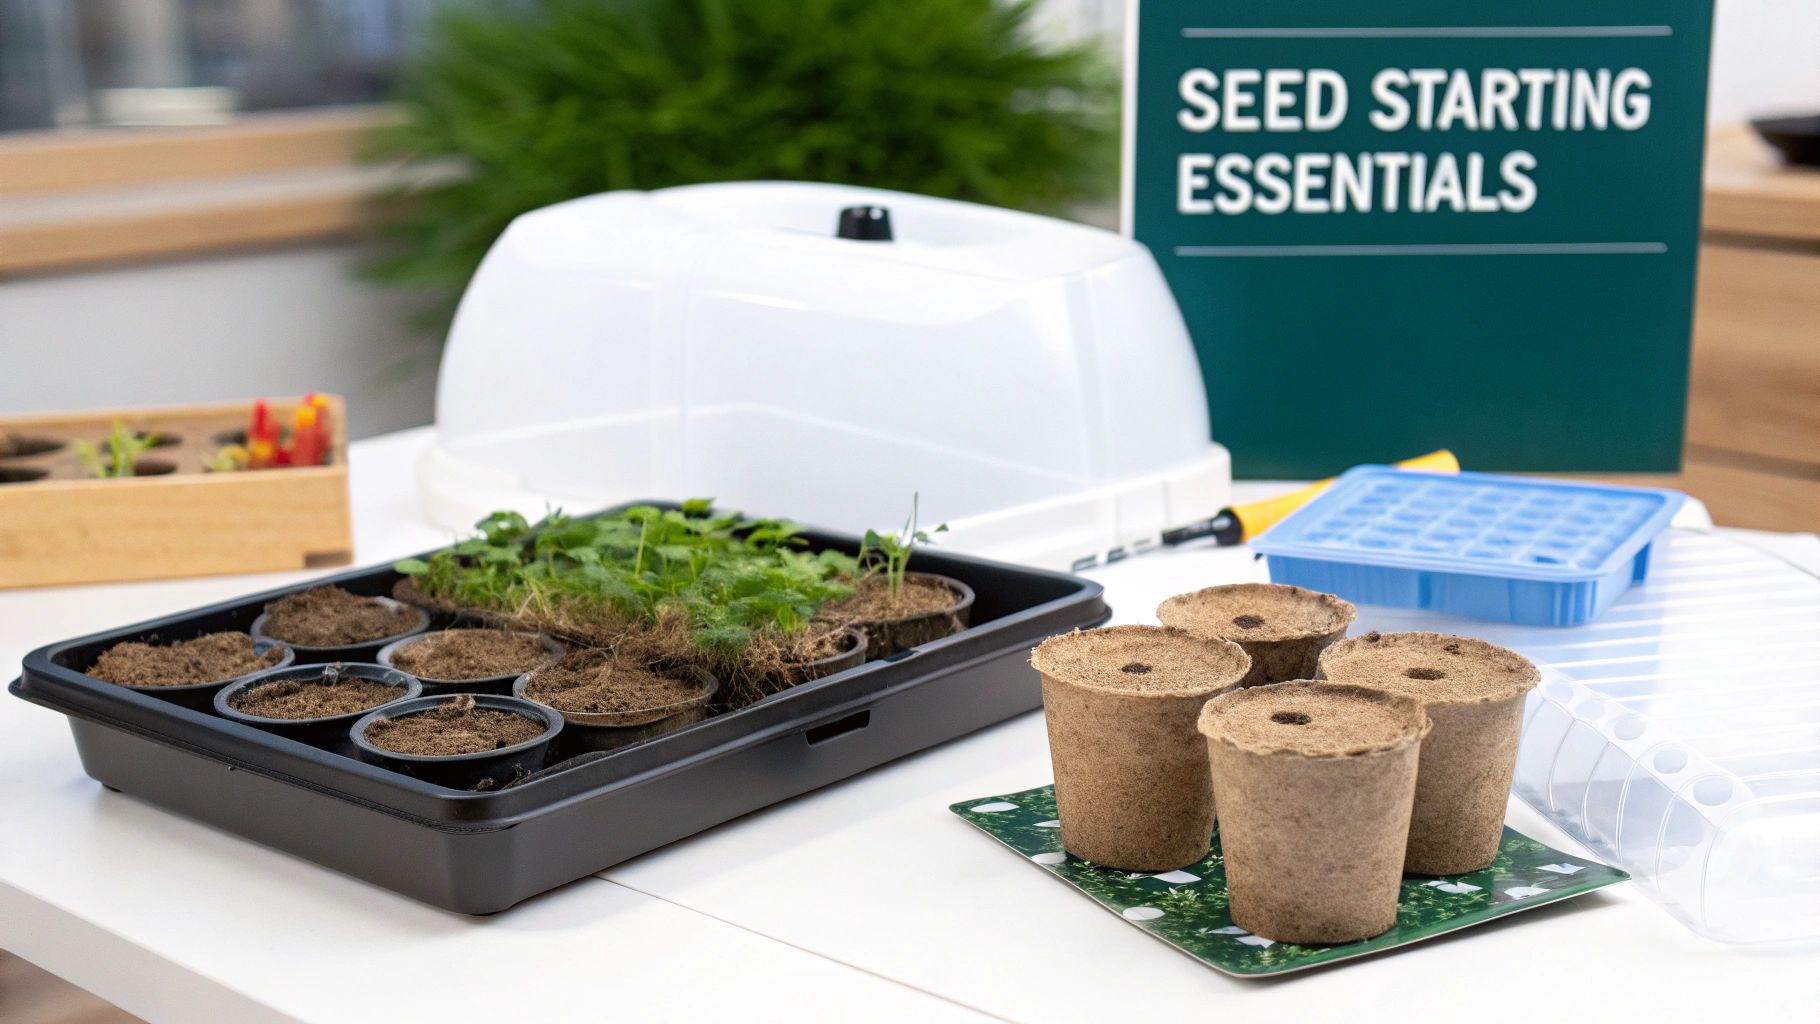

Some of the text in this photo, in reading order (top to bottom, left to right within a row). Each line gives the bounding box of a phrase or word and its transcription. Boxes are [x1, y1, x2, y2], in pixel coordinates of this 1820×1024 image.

[1178, 68, 1651, 131] SEED STARTING
[1177, 151, 1537, 214] ESSENTIALS
